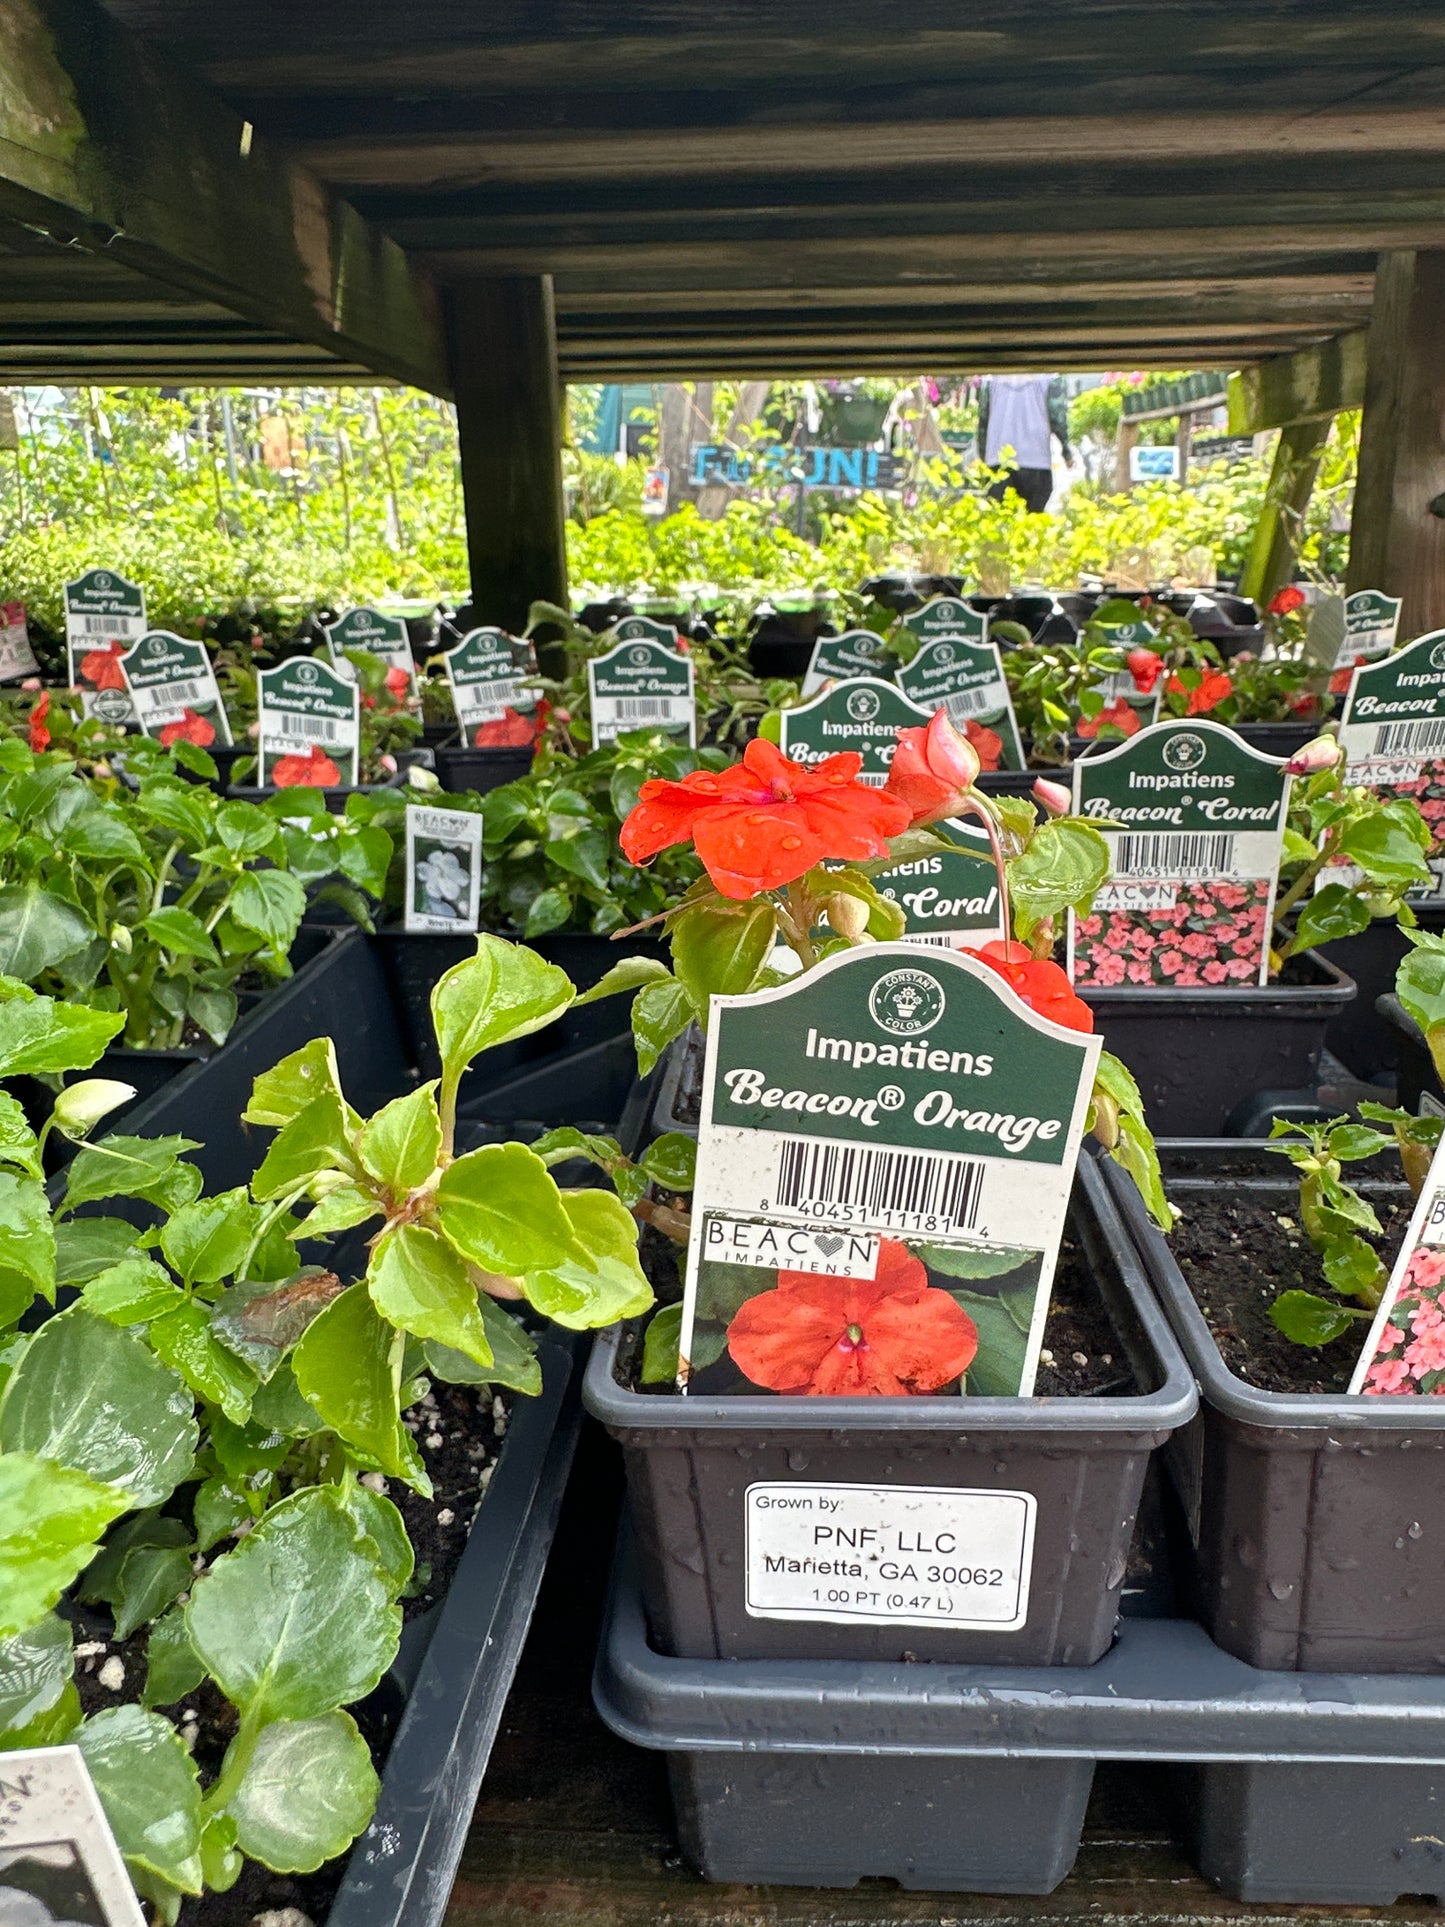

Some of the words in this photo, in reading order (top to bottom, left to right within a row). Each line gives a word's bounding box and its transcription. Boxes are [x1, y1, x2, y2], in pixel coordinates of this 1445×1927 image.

[1128, 771, 1235, 791] Impatiens
[1197, 797, 1279, 821] Coral
[1129, 867, 1169, 877] 40451
[1177, 867, 1217, 877] 11181
[902, 886, 998, 918] Coral
[885, 973, 936, 990] CONSTANT
[885, 1017, 923, 1030] COLOR
[805, 1028, 994, 1077] Impatiens
[913, 1090, 1063, 1153] Orange
[759, 1199, 769, 1211] 8
[798, 1199, 868, 1223] 40451
[883, 1210, 952, 1233] 11181
[979, 1226, 990, 1238] 4
[724, 1251, 852, 1276] IMPATIENS
[755, 1495, 812, 1509] Grown
[819, 1497, 844, 1513] by:
[814, 1525, 886, 1553] PNF,
[898, 1531, 957, 1554] LLC
[765, 1556, 869, 1581] Marietta,
[879, 1562, 919, 1582] GA
[927, 1565, 1003, 1586] 30062
[812, 1589, 850, 1603] 1.00
[855, 1592, 881, 1606] PT
[886, 1593, 932, 1610] (0.47
[937, 1597, 954, 1613] L)
